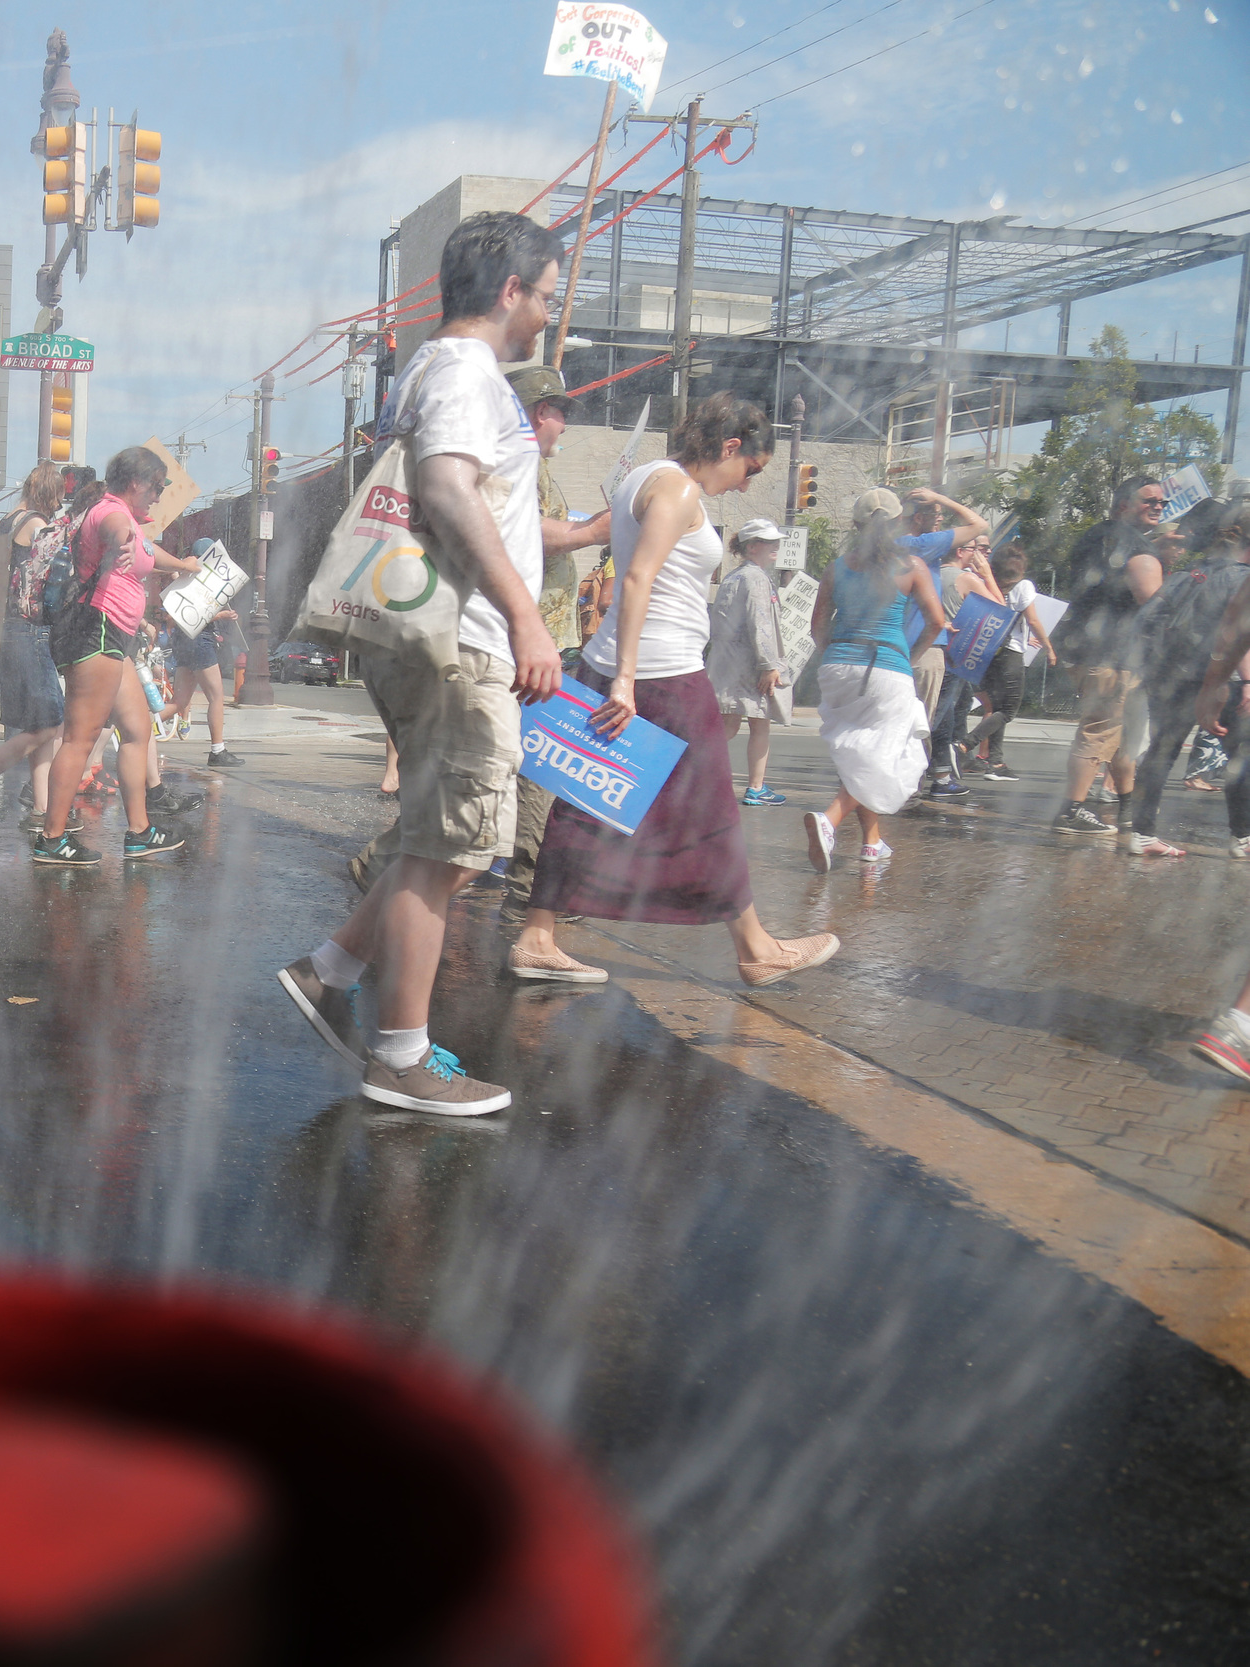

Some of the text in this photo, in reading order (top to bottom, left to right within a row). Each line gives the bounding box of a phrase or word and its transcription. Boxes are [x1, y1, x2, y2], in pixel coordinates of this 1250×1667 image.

[556, 5, 578, 23] Get
[581, 21, 632, 43] OUT
[558, 35, 576, 55] of
[18, 342, 92, 359] BROAD ST
[2, 357, 92, 370] AVENUE OF THE ARTS
[786, 530, 800, 539] NO
[202, 547, 238, 581] May
[340, 527, 438, 612] 70
[215, 582, 236, 606] B
[794, 578, 818, 599] PEOPLE
[331, 599, 380, 622] years
[785, 591, 811, 614] WITHOUT
[790, 614, 809, 631] JUST
[964, 614, 1005, 670] Bernie
[785, 649, 799, 663] THE
[556, 719, 629, 763] FOR PRESIDENT
[522, 728, 635, 810] Bernie
